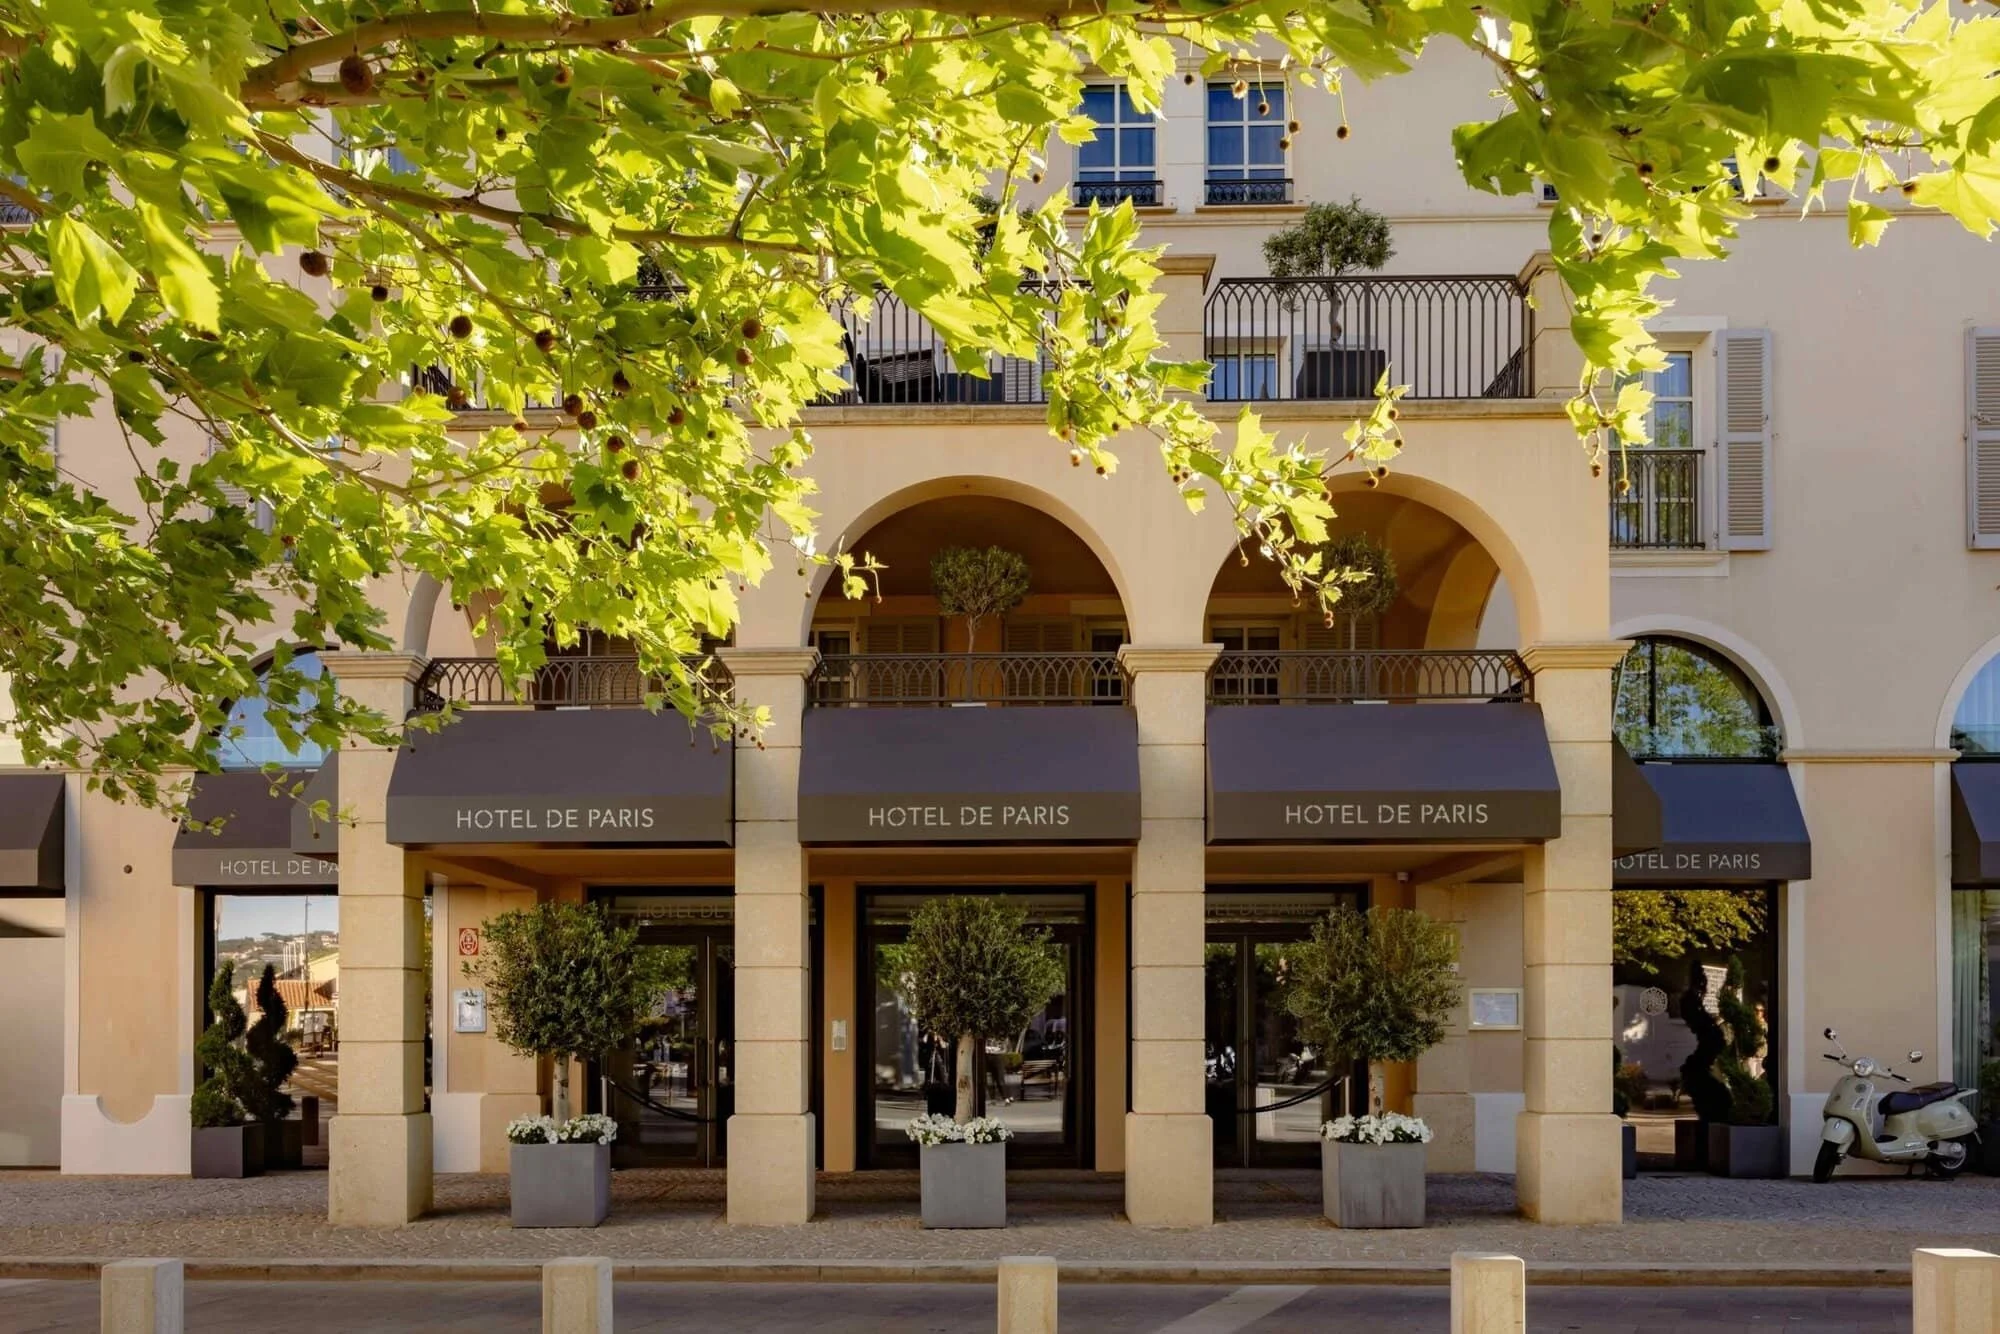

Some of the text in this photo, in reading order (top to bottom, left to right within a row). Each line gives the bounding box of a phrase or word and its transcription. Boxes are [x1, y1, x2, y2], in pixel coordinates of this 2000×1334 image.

[457, 808, 654, 829] HOTEL DE PARIS
[869, 805, 1069, 827] HOTEL DE PARIS
[1286, 804, 1489, 825] HOTEL DE PARIS
[220, 860, 281, 876] HOTEL
[287, 860, 312, 875] DE
[1612, 853, 1761, 869] OTEL DE PARIS
